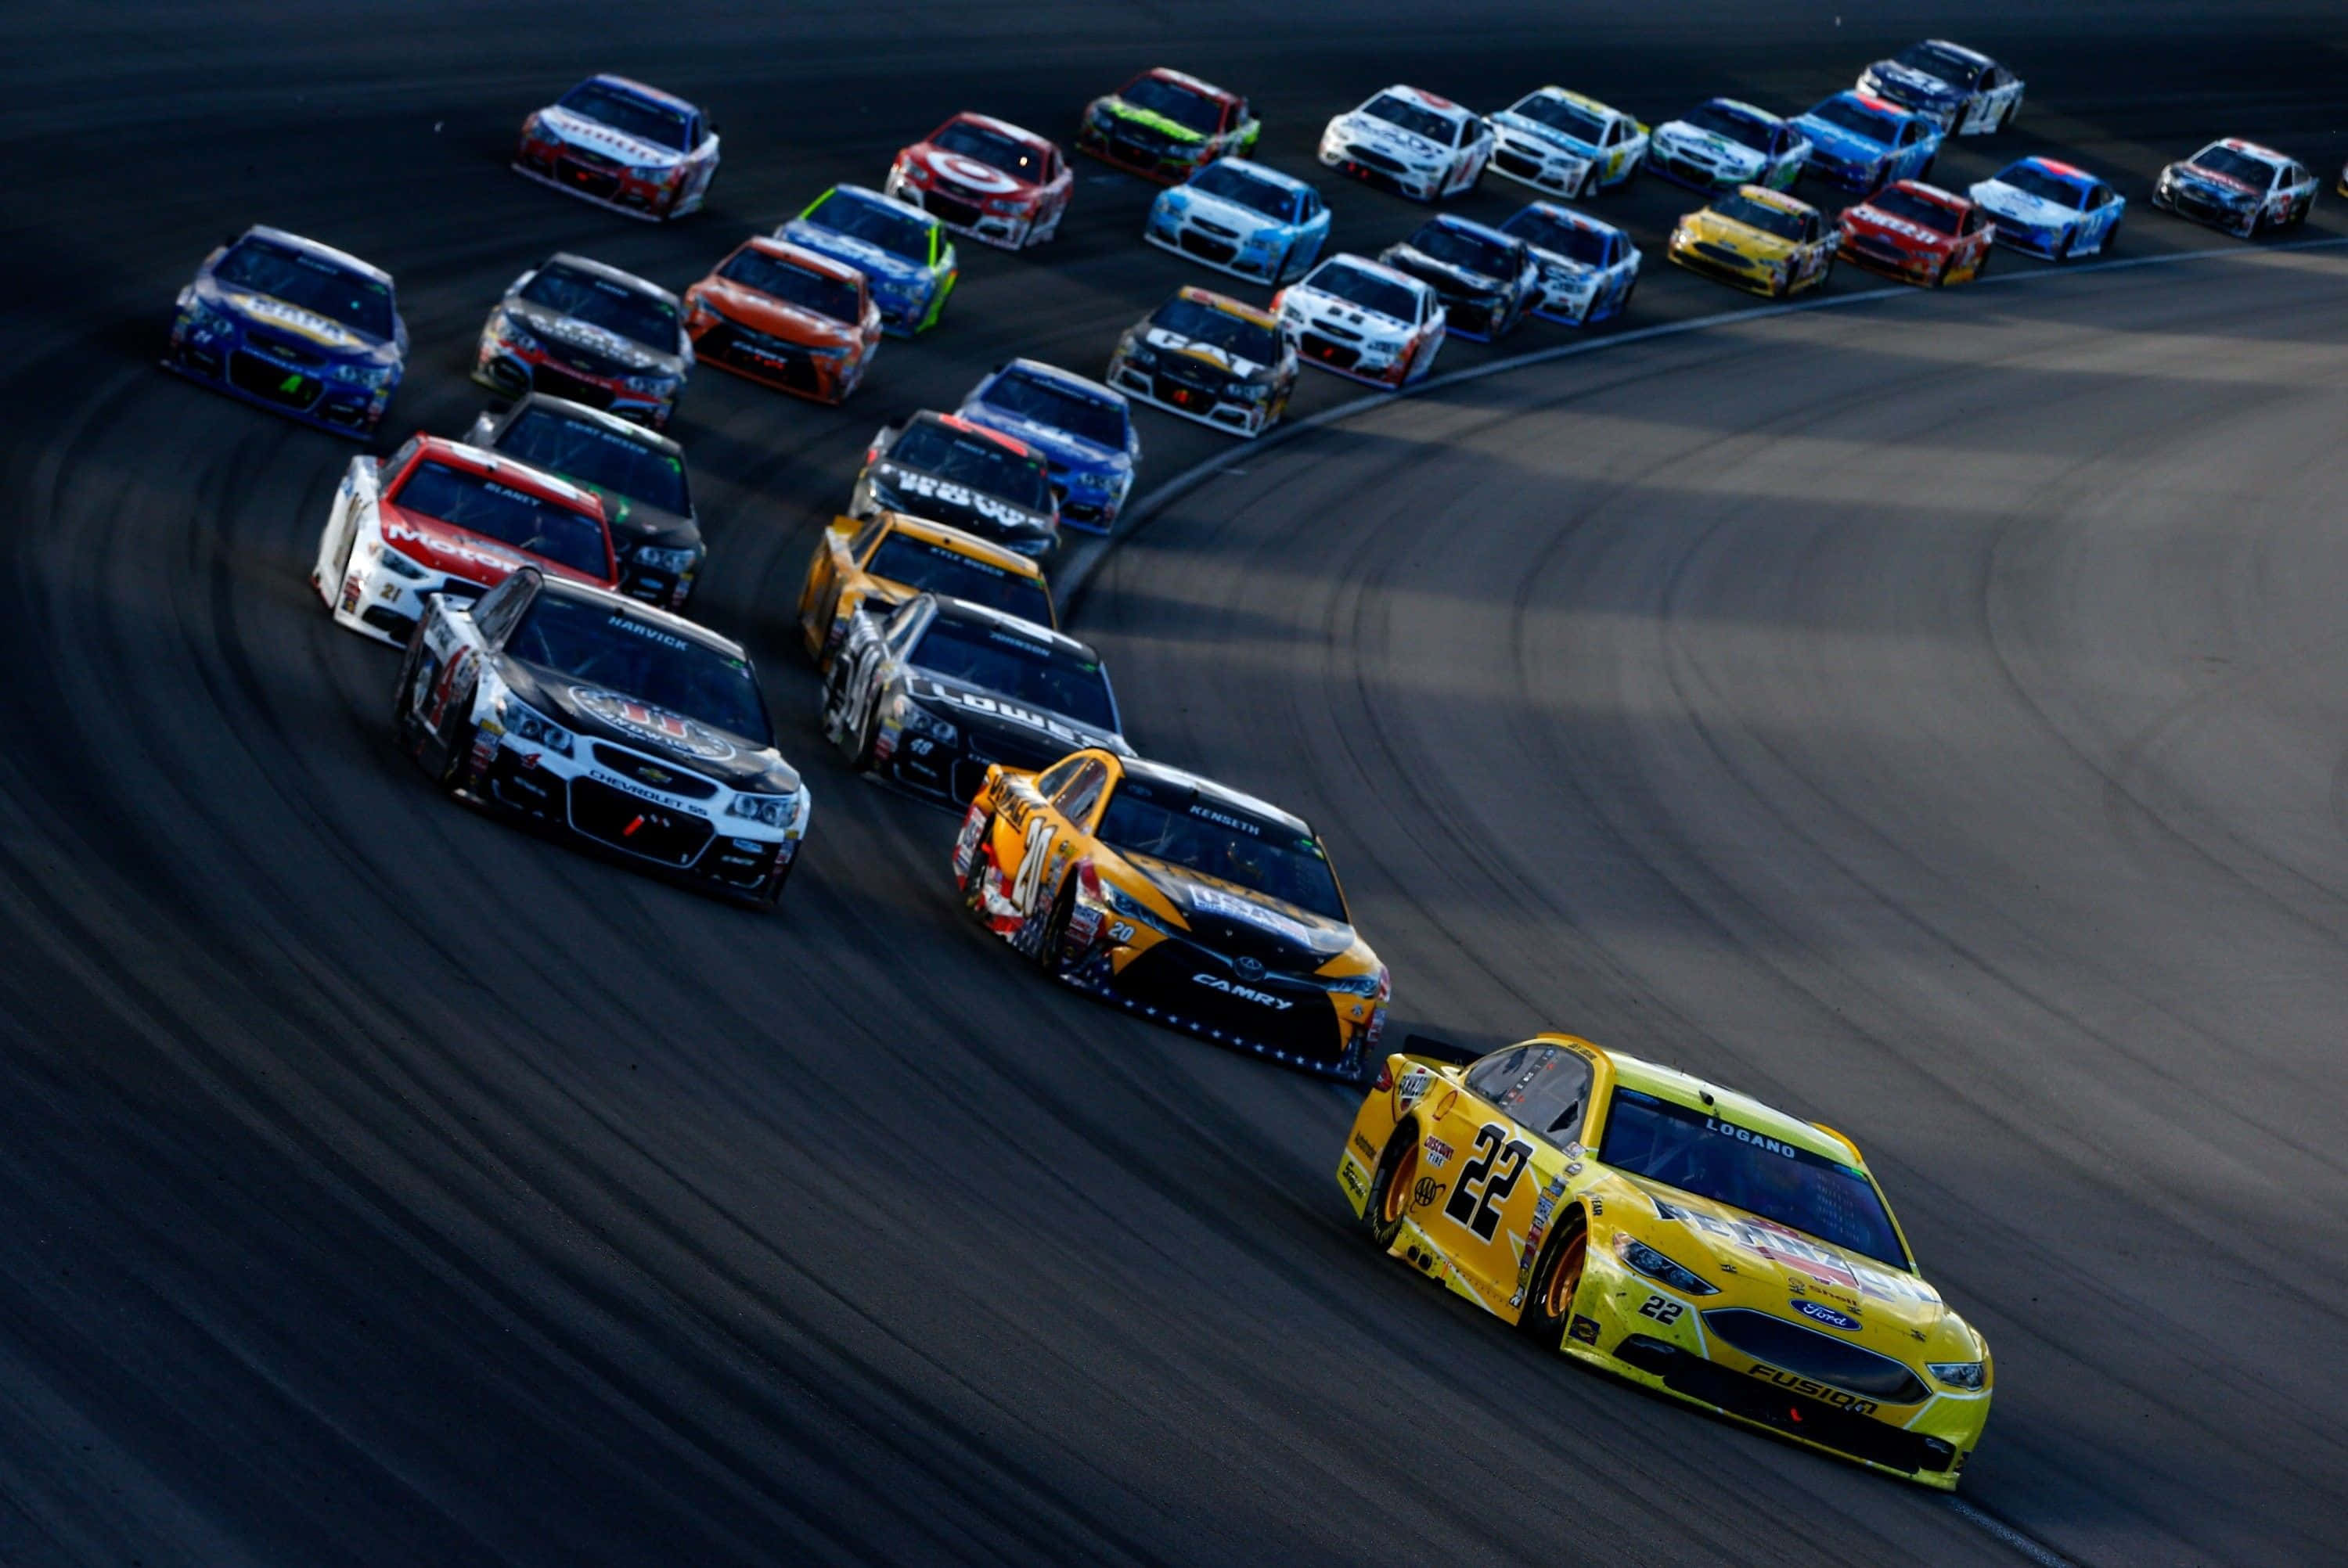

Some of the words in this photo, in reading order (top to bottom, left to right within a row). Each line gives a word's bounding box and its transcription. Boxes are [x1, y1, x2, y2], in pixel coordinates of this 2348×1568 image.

[483, 481, 542, 508] BLANEY
[380, 582, 402, 603] 21
[608, 614, 690, 653] HARVICK
[910, 737, 934, 756] 48
[520, 753, 542, 771] 4
[589, 768, 682, 809] CHEVROLET
[688, 803, 708, 817] SS
[1189, 804, 1260, 836] KENSETH
[1107, 920, 1136, 944] 20
[1192, 973, 1294, 1010] CAMRY
[1705, 1117, 1796, 1160] LOGANO
[1428, 1151, 1444, 1167] TIRE
[1443, 1122, 1534, 1246] 22
[1809, 1284, 1858, 1307] Shell
[1637, 1294, 1684, 1327] 22
[1802, 1304, 1848, 1328] Ford
[1748, 1363, 1878, 1415] FUSION
